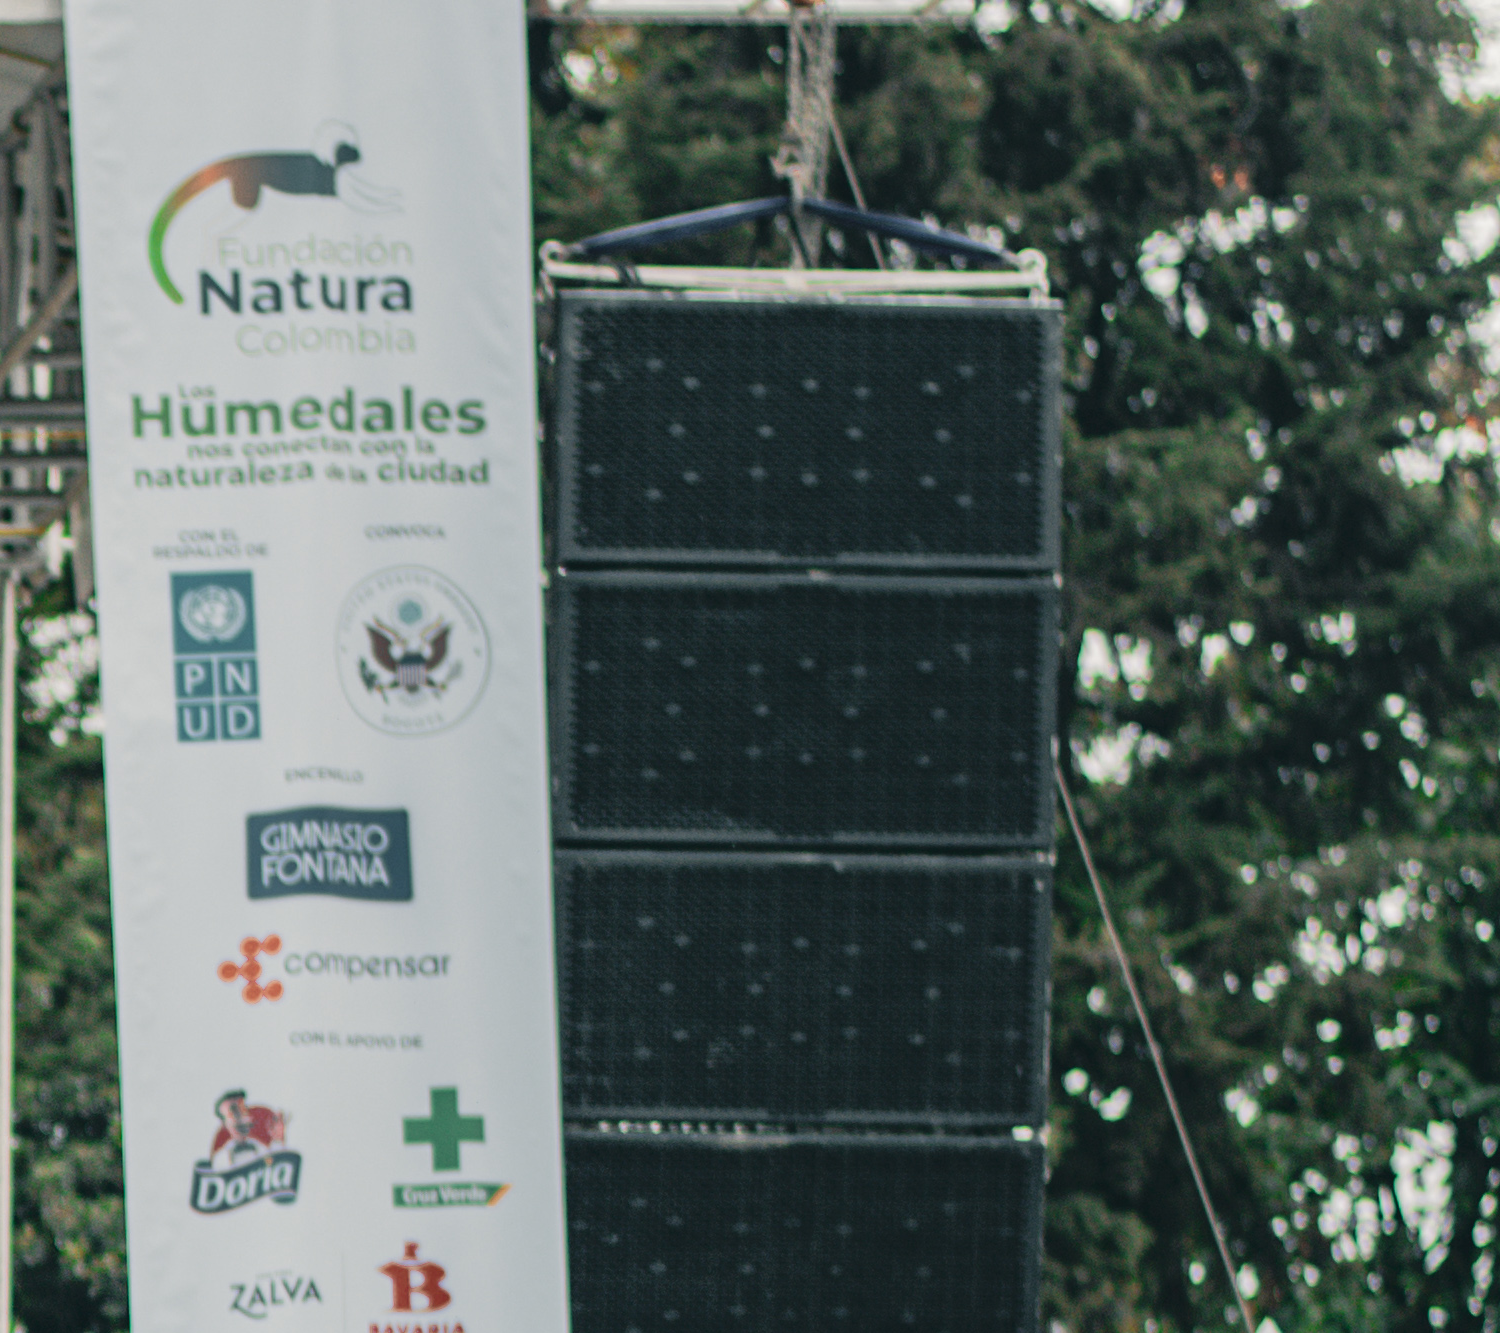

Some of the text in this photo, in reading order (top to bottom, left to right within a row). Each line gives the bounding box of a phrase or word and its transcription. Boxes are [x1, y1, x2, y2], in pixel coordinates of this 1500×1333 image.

[218, 234, 414, 269] Fundación
[197, 268, 414, 316] Natura
[235, 323, 416, 357] Colombia
[187, 443, 233, 459] nos
[360, 439, 407, 457] con
[415, 437, 435, 455] la
[134, 458, 315, 488] naturaleza
[377, 458, 491, 485] ciudad
[260, 821, 389, 855] GIMNASIO
[260, 852, 390, 887] FONTANA
[284, 951, 451, 982] compensar
[198, 1160, 293, 1211] Doria
[229, 1279, 322, 1319] ZALVA
